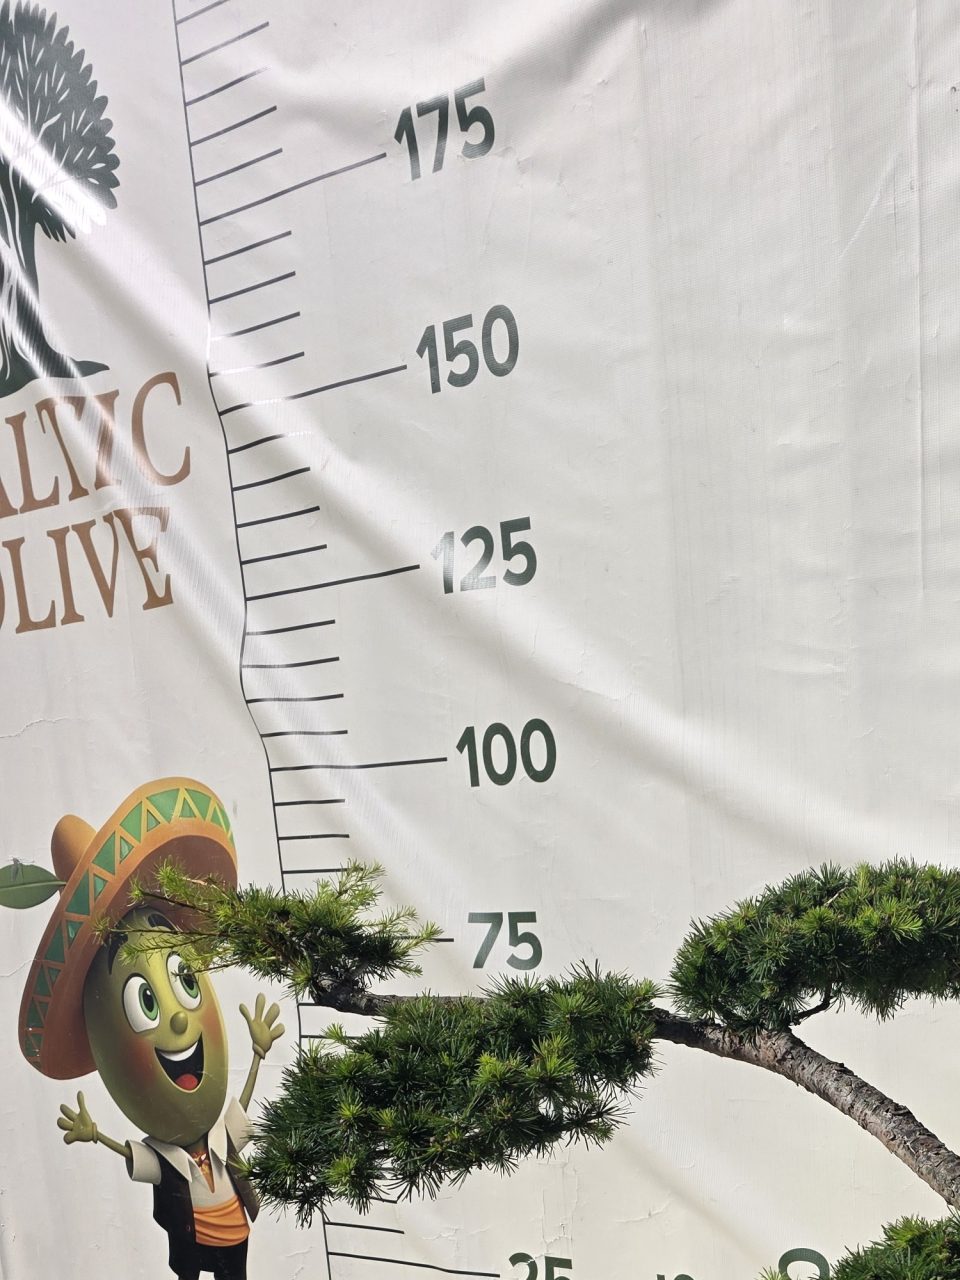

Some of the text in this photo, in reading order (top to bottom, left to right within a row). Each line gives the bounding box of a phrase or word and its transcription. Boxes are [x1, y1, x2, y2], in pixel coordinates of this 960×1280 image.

[394, 77, 496, 181] 175
[416, 304, 520, 394] 150
[0, 506, 174, 634] LIVE
[431, 517, 538, 594] 125
[456, 719, 557, 787] 100
[467, 911, 543, 970] 75
